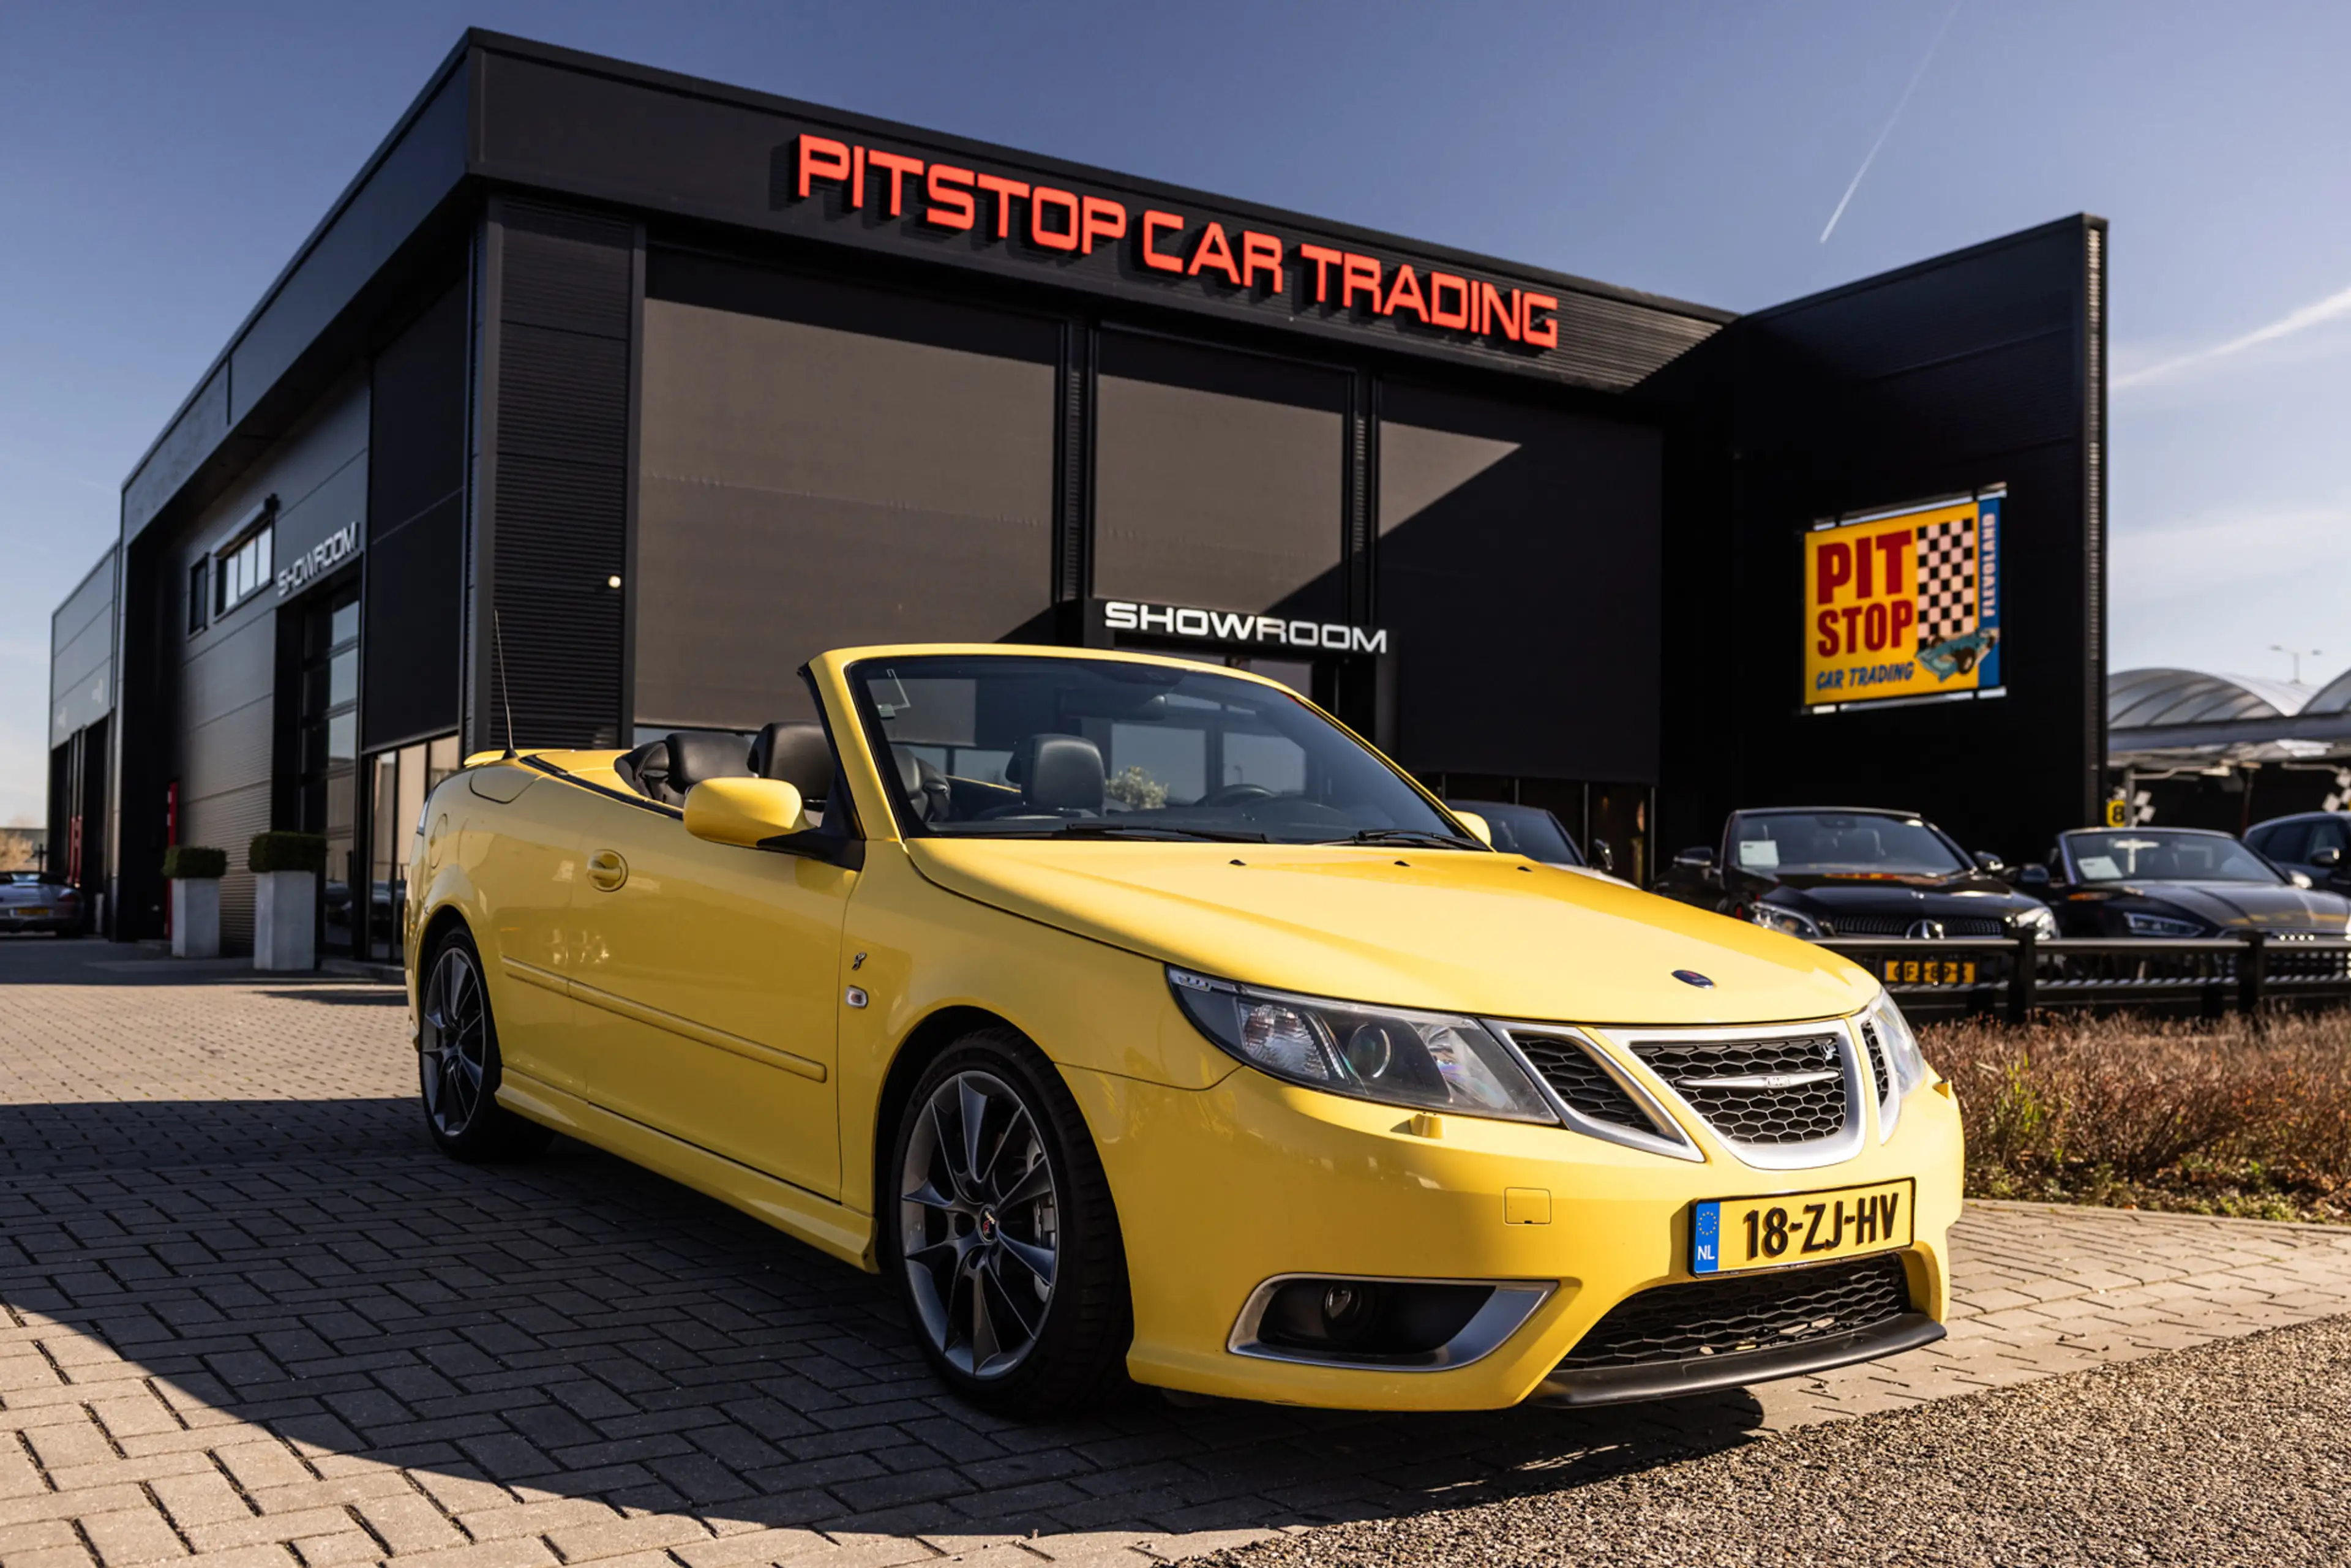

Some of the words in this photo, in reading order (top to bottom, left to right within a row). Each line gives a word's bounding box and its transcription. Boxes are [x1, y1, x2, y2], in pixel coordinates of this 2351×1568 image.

[798, 133, 1127, 255] PITSTOP
[1143, 209, 1283, 293] CAR
[1301, 243, 1558, 348] TRADING
[277, 521, 357, 597] SHOWROOM
[1817, 529, 1913, 606] PIT
[1982, 512, 1996, 618] FLEVOLAND
[1104, 601, 1387, 653] SHOWROOM
[1817, 599, 1914, 659] STOP
[1816, 669, 1845, 691] CAR
[1849, 661, 1914, 688] TRADING
[1697, 1244, 1715, 1261] NL
[1744, 1192, 1899, 1261] 18-ZJ-HV
